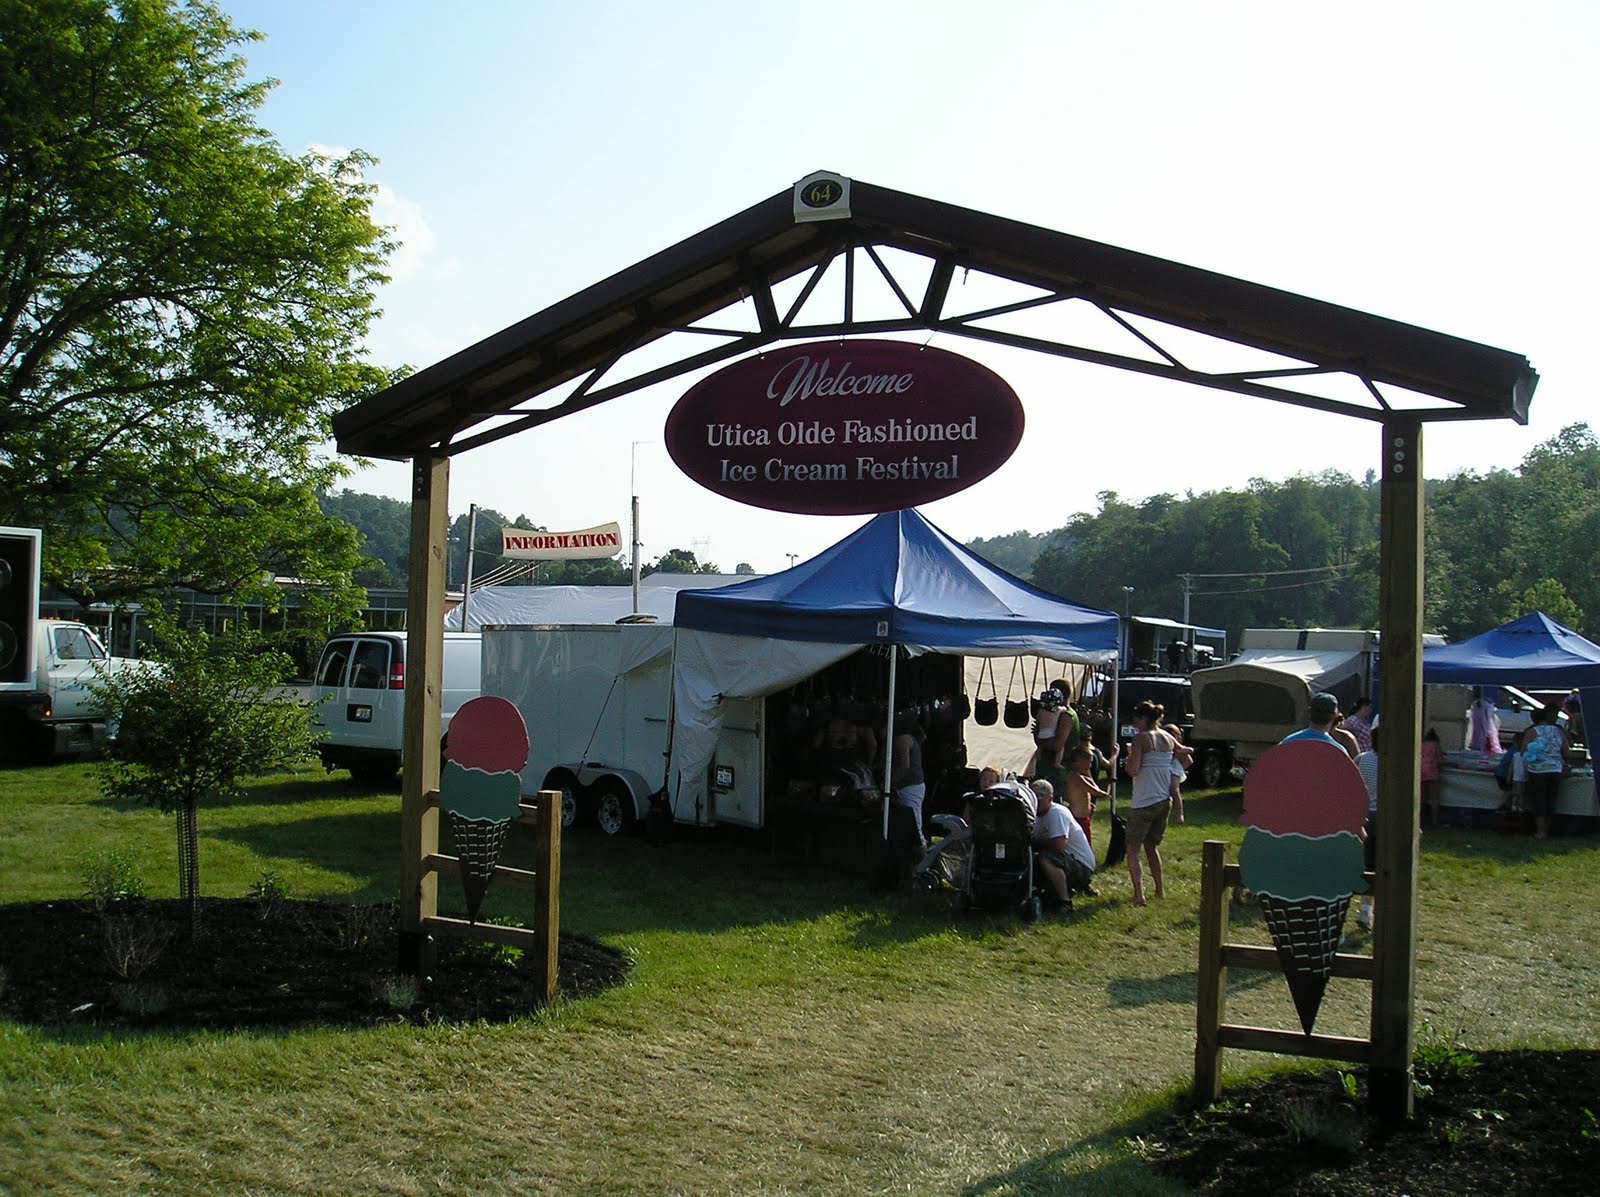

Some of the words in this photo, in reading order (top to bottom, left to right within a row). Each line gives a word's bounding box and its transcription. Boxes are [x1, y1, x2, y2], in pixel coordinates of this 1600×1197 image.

[810, 184, 832, 203] 64
[766, 355, 914, 407] Welcome
[706, 422, 771, 447] Utica
[777, 421, 836, 445] Olde
[843, 416, 978, 443] Fashioned
[720, 459, 757, 482] Ice
[764, 457, 848, 481] Cream
[856, 454, 960, 480] Festival
[505, 533, 618, 549] INFORMATION
